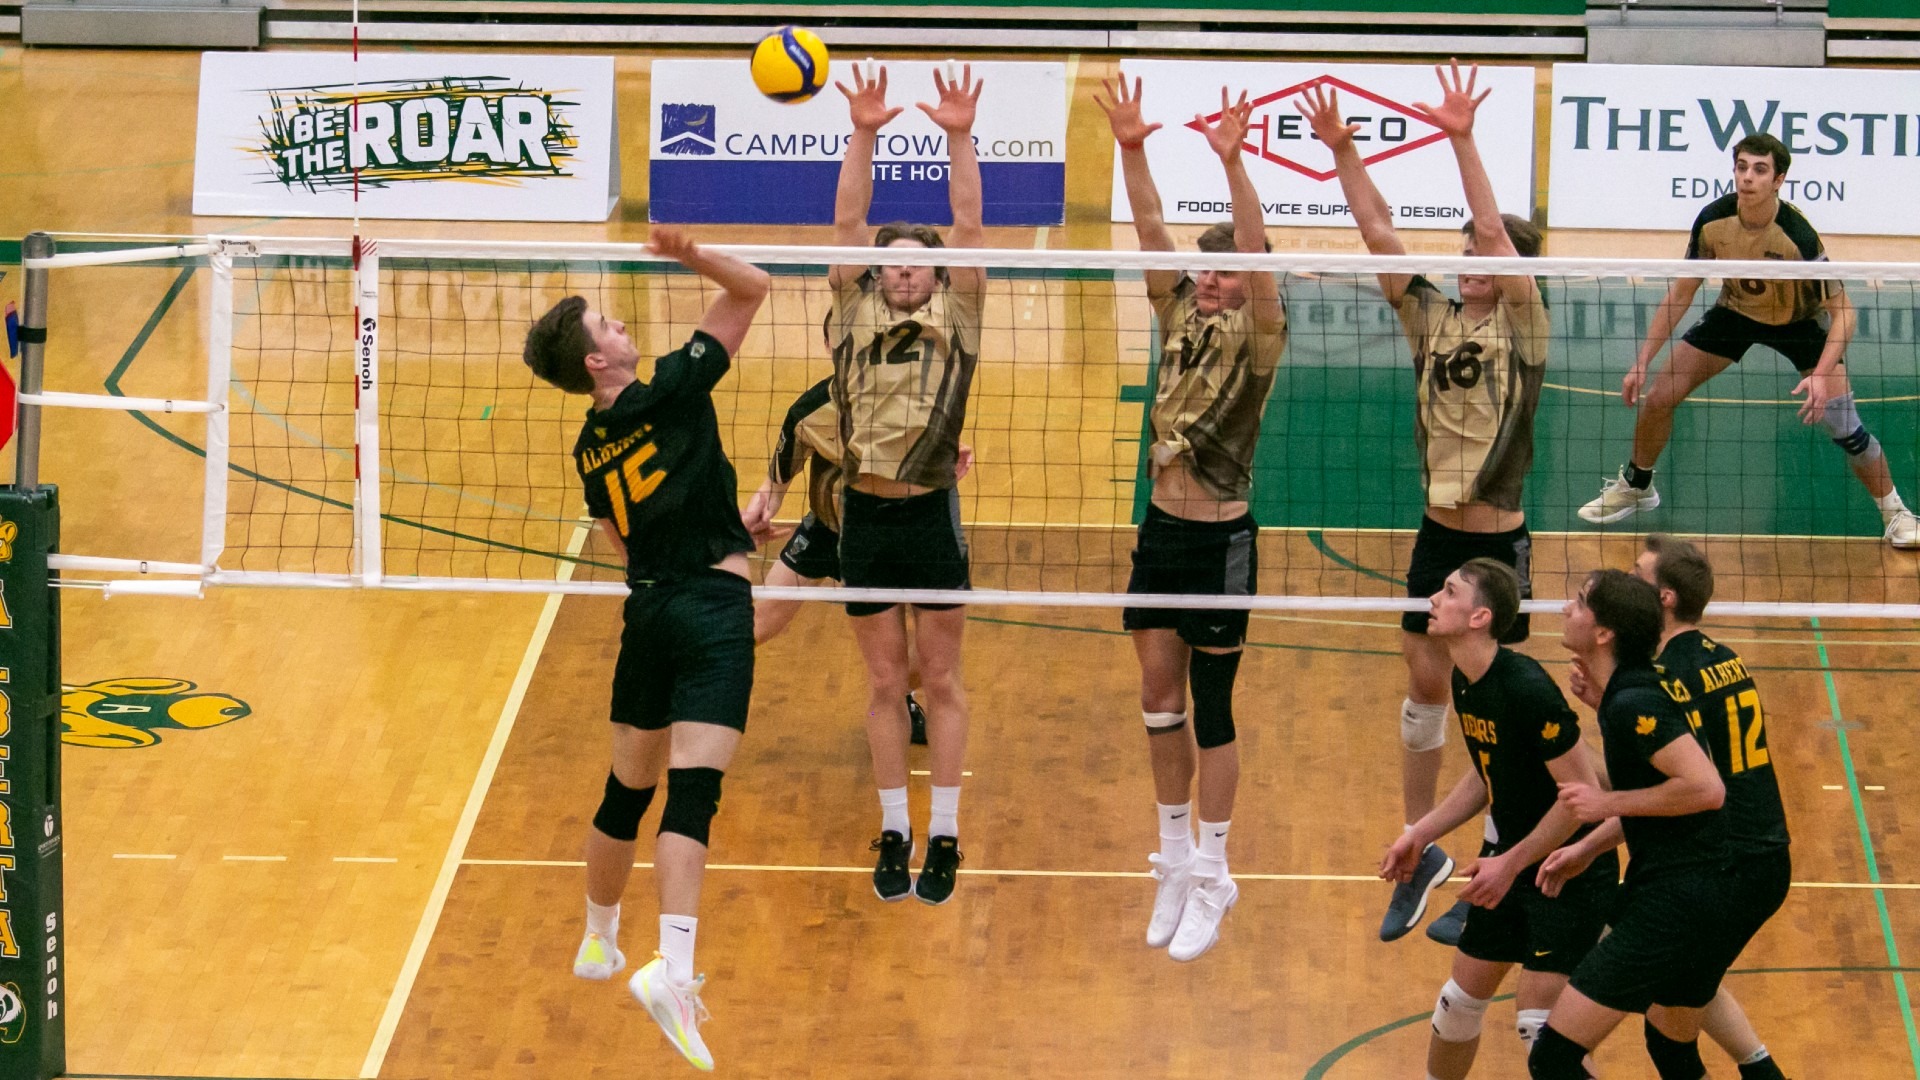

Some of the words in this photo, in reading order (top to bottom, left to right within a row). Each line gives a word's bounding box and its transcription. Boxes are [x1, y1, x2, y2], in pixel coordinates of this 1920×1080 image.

[293, 110, 335, 144] BE
[349, 95, 552, 169] ROAR
[1559, 96, 1690, 152] THE
[1697, 98, 1920, 157] WESTI
[282, 140, 344, 177] THE
[1177, 200, 1302, 216] FOODSVICE
[1400, 205, 1465, 218] DESIGN
[1671, 177, 1845, 202] EDMTON
[361, 334, 374, 391] Senoh
[869, 319, 923, 366] 12
[1430, 340, 1484, 392] 16
[1725, 689, 1770, 774] 12
